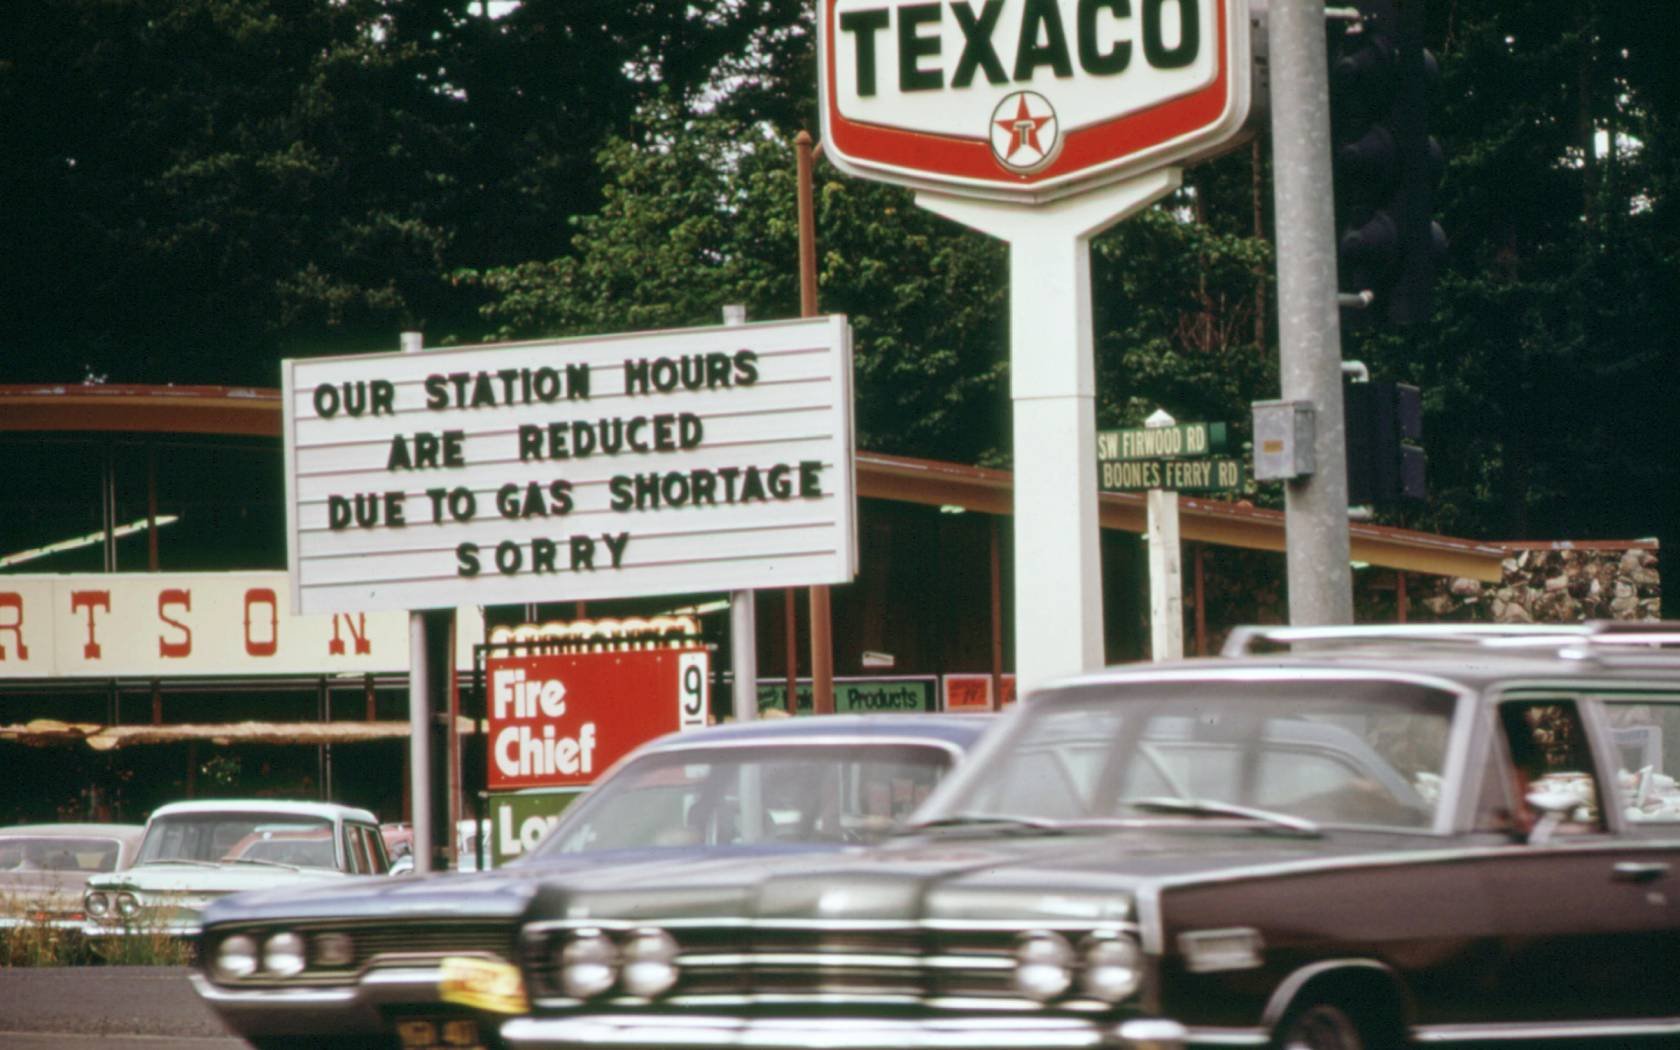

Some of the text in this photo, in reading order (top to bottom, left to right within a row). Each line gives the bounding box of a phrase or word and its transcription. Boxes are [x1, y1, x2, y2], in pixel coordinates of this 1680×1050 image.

[840, 0, 1200, 97] TEXACO
[313, 350, 759, 419] OUR STATION HOURS
[386, 413, 703, 471] ARE REDUCED
[1098, 426, 1206, 460] SW FIRWOOD RD
[328, 461, 824, 530] DUE TO GAS SHORTAGE
[1103, 461, 1238, 488] BOONES FERRY RD
[455, 532, 629, 578] SORRY
[493, 668, 567, 719] Fire
[684, 664, 703, 716] 9
[848, 687, 917, 709] Products
[494, 722, 596, 777] Chief
